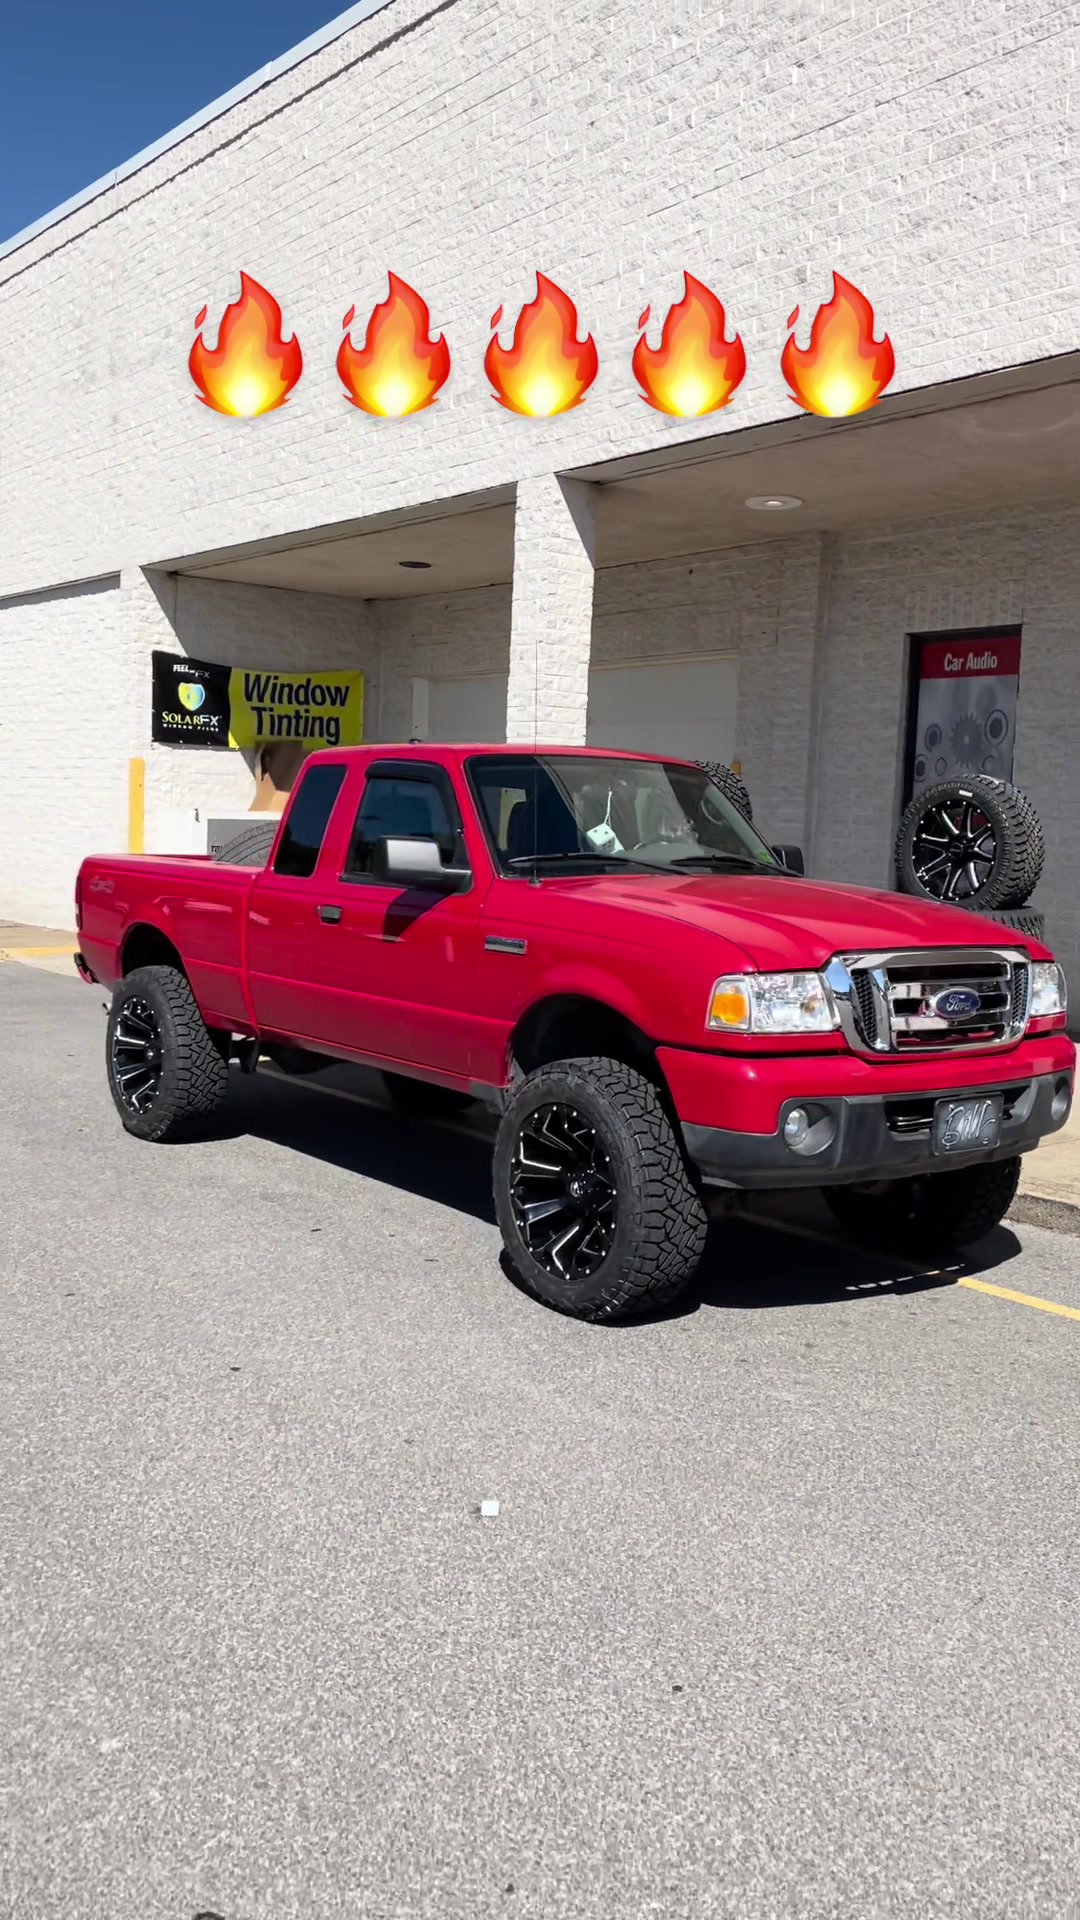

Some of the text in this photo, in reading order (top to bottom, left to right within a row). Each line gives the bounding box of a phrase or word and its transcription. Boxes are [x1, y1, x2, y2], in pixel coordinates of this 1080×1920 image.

[944, 651, 998, 671] Car Audio
[244, 672, 350, 707] Window
[250, 706, 341, 745] Tinting
[946, 994, 972, 1011] Ford
